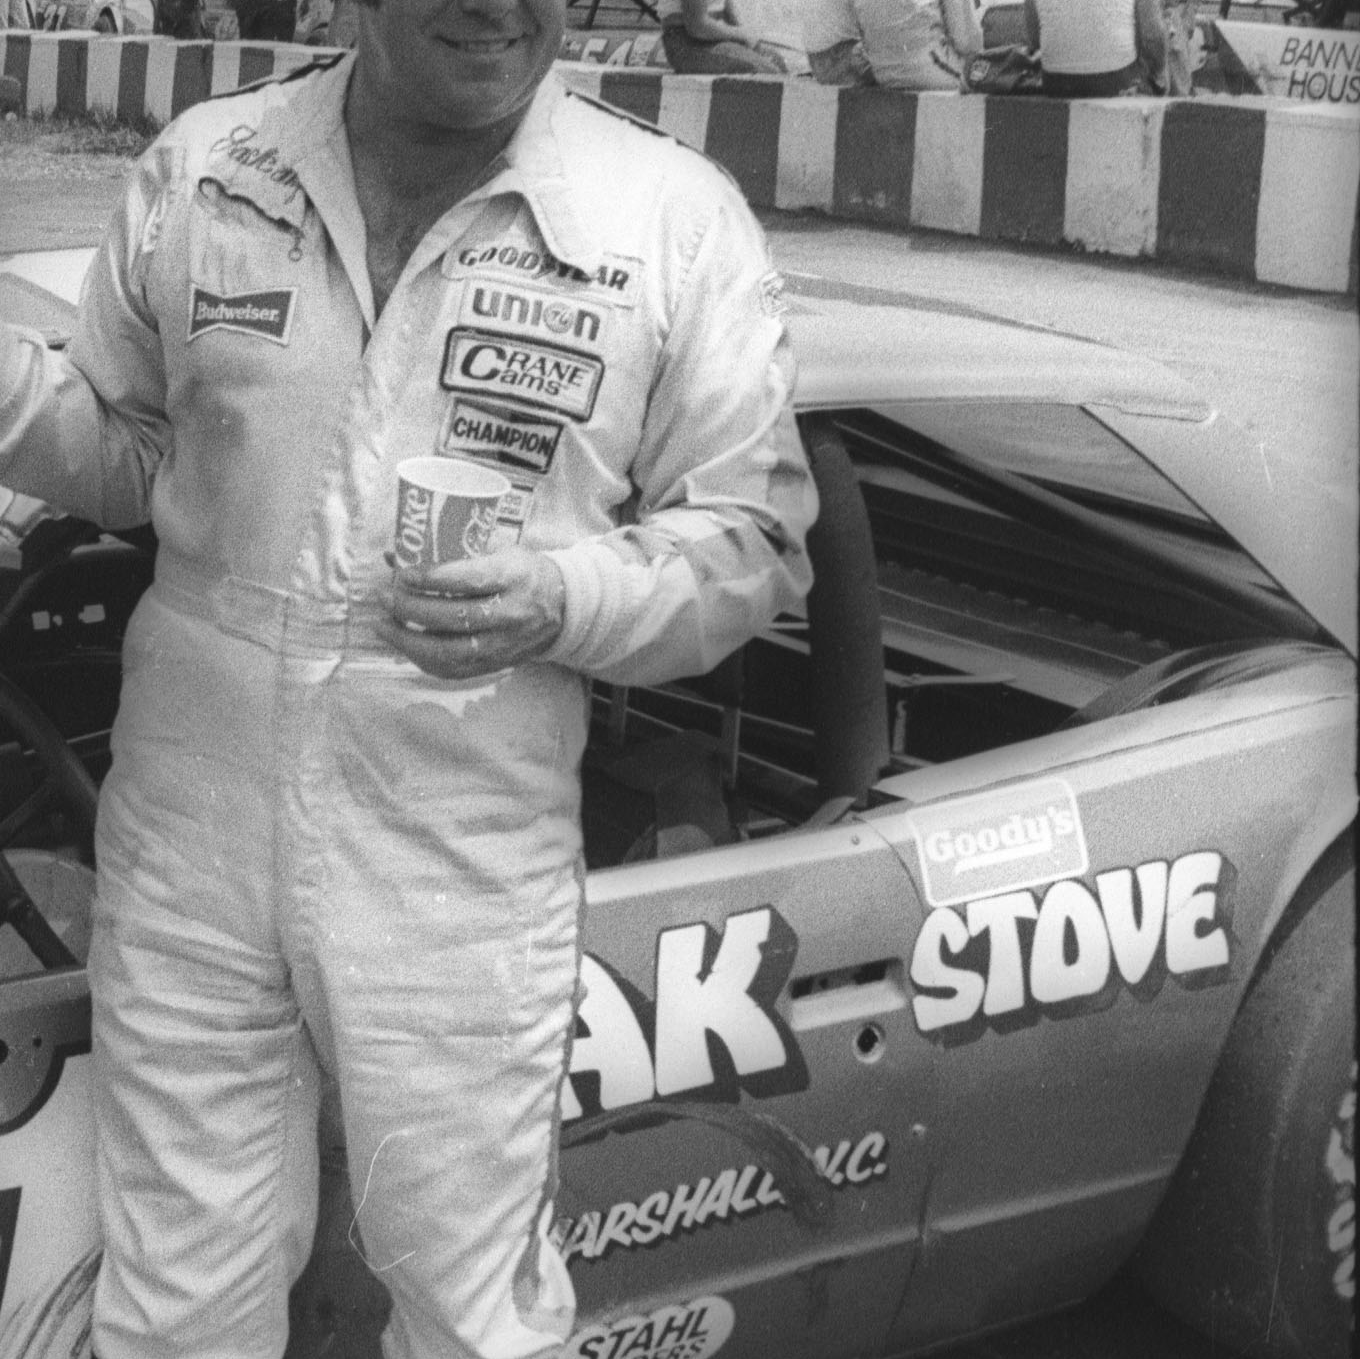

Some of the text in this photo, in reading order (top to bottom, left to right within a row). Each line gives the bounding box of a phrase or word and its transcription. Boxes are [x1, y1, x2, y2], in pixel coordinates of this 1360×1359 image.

[1279, 37, 1360, 72] BANN
[460, 343, 589, 388] CRANE
[452, 416, 554, 457] CHAMPION
[395, 488, 431, 569] Coke
[924, 805, 1074, 863] Goody's
[910, 850, 1230, 1032] STOVE
